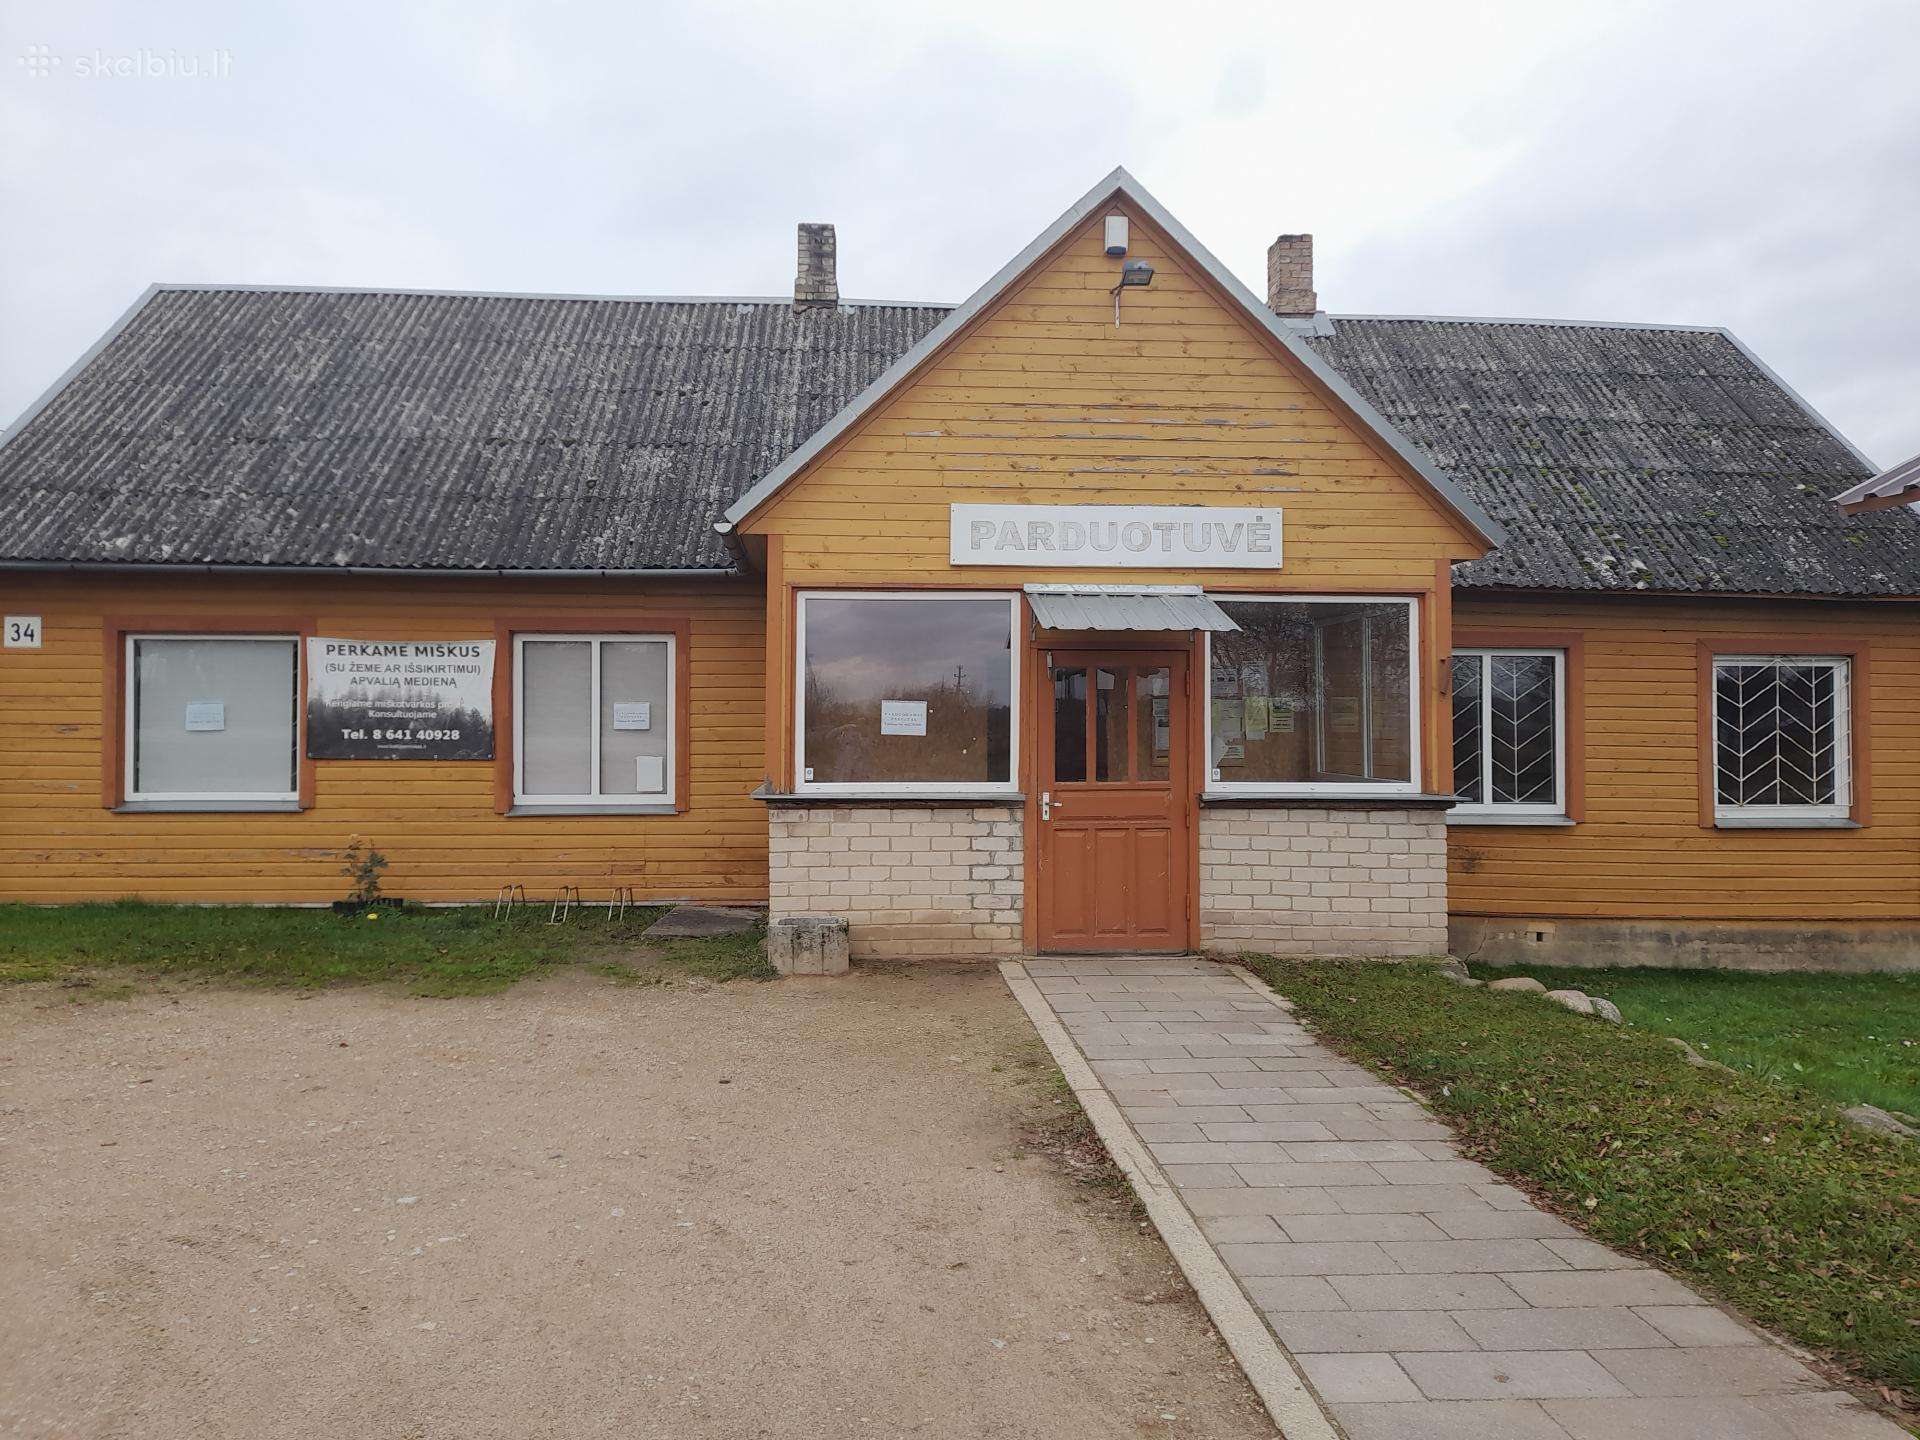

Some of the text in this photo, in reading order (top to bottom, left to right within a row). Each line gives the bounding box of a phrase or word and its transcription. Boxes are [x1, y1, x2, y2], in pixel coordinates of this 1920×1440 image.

[970, 515, 1273, 553] PARDUOTUVĖ
[11, 623, 34, 642] 34
[326, 644, 480, 658] PERKAME MIŠKUS
[325, 661, 481, 676] (SU ŽEME AR IŠSIKIRTIMUI)
[350, 676, 457, 688] APVALIĄ MEDIENĄ
[368, 710, 437, 720] Konsultuojame
[341, 729, 460, 741] Tel. 8 641 40928
